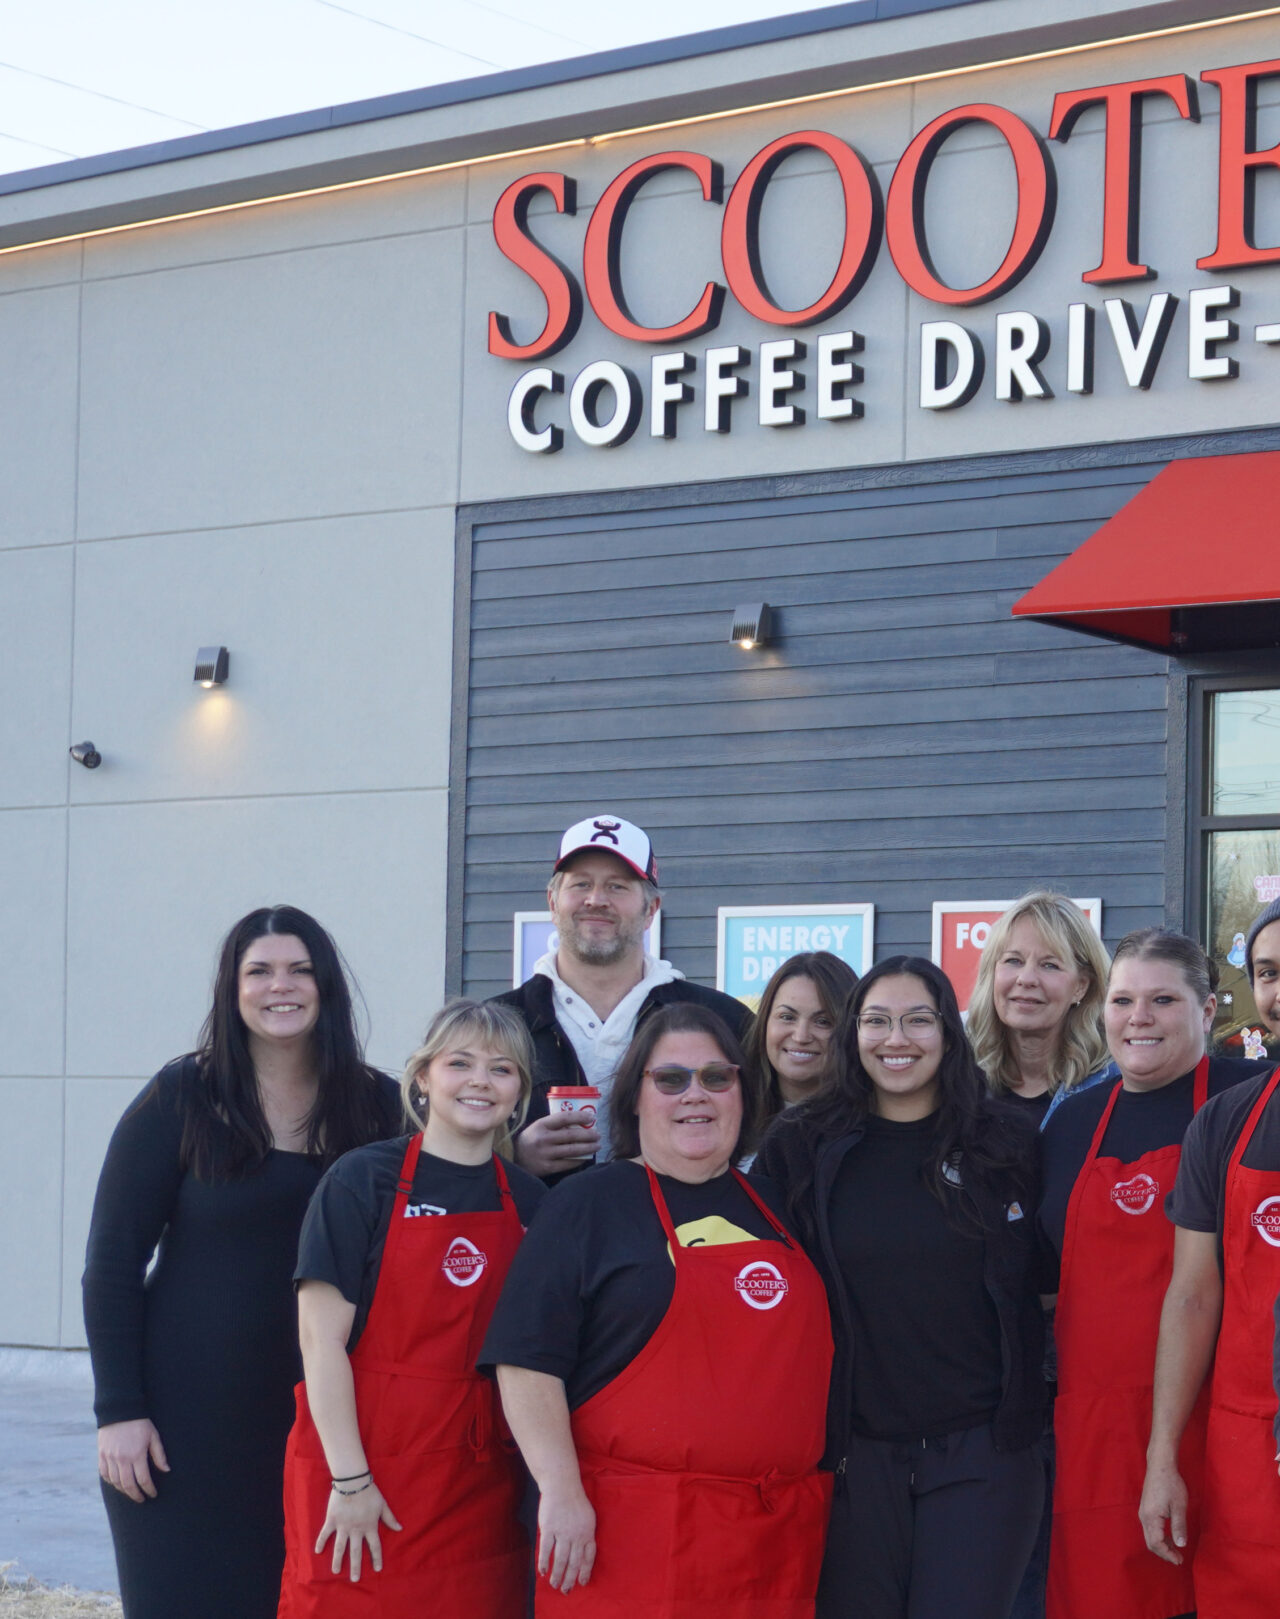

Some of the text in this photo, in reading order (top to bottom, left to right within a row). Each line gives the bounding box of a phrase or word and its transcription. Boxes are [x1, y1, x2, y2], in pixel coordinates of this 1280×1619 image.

[507, 330, 864, 454] COFFEE
[743, 925, 849, 951] ENERGY
[737, 1279, 787, 1290] SCOOTER'S
